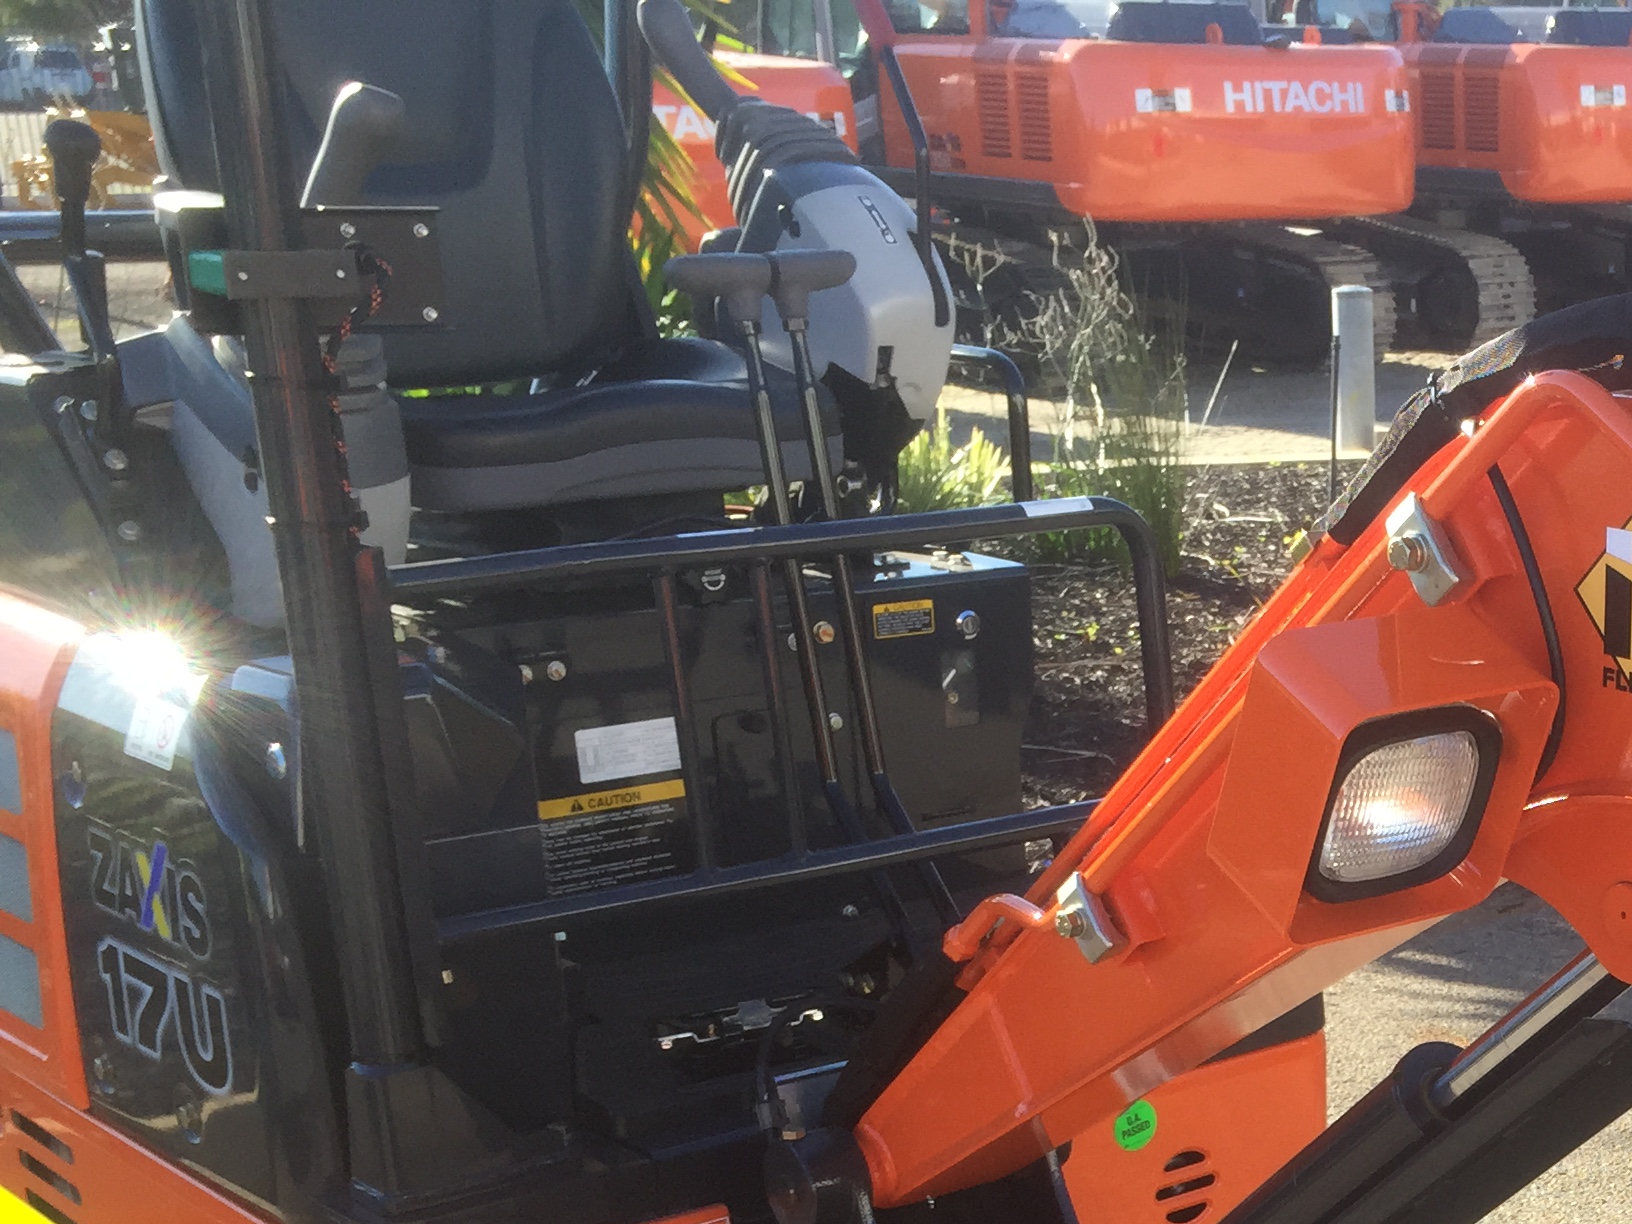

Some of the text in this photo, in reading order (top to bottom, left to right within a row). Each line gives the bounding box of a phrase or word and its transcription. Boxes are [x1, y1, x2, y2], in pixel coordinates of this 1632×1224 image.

[1223, 80, 1366, 114] HITACHI
[587, 791, 642, 810] CAUTION
[86, 826, 214, 962] ZAXIS
[97, 935, 234, 1096] 17U
[1121, 1120, 1151, 1140] PASSED
